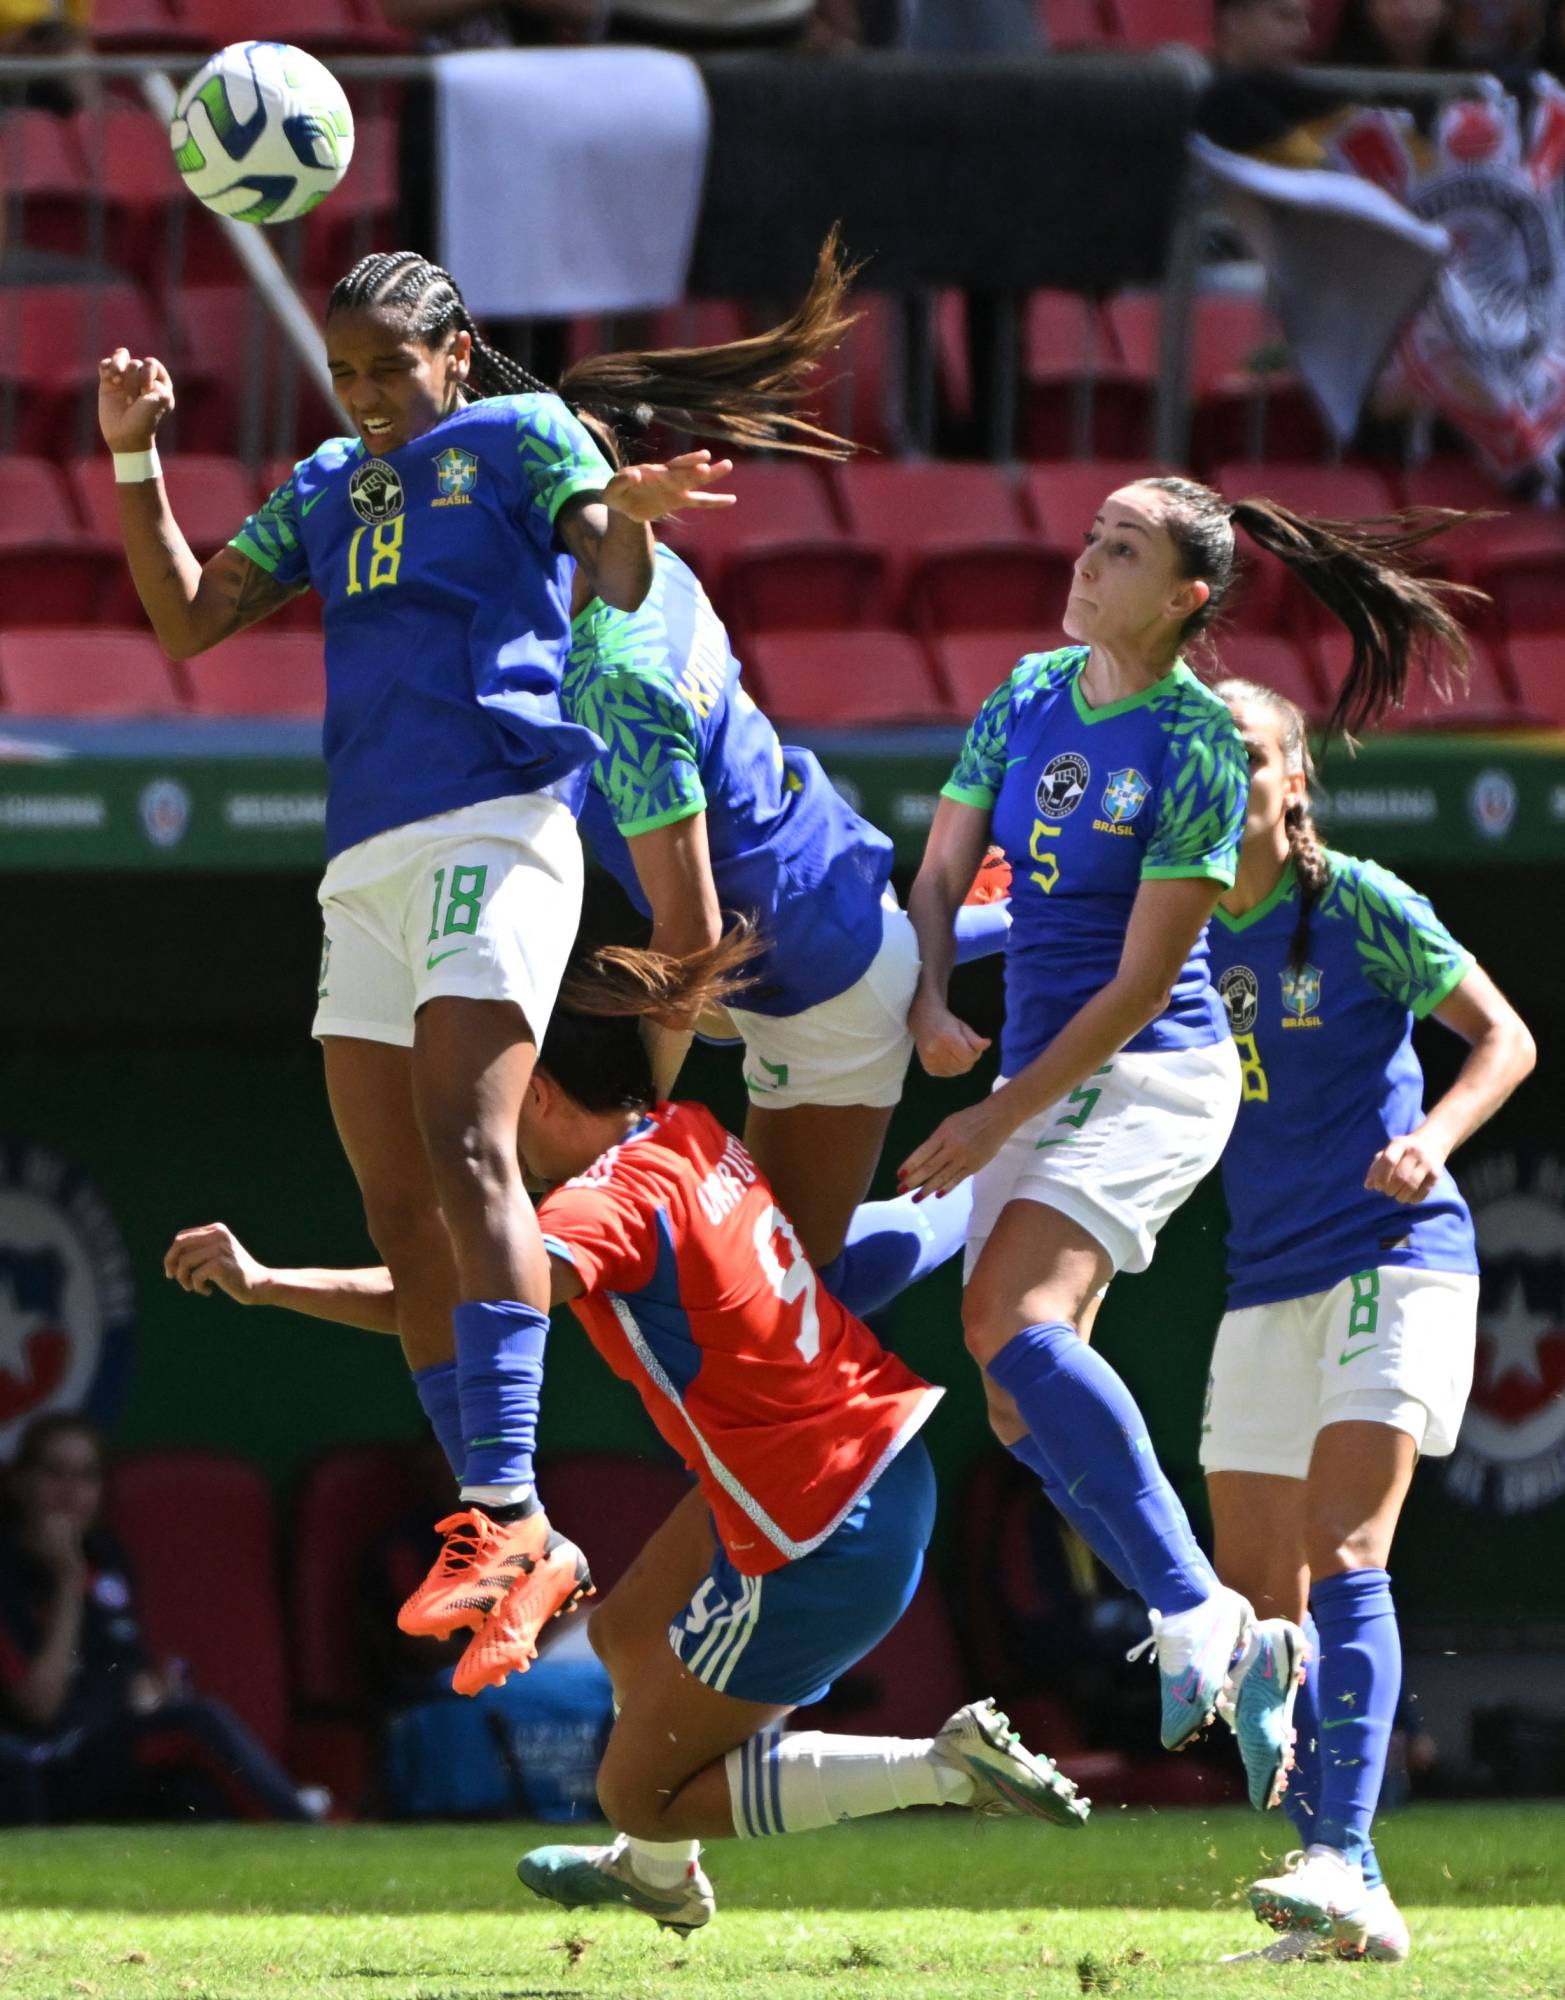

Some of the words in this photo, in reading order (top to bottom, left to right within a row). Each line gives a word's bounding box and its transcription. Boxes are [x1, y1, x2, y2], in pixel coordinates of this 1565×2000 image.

[431, 494, 472, 507] BRASIL
[346, 513, 405, 595] 18
[1029, 818, 1062, 895] 5
[1092, 819, 1135, 836] BRASIL
[427, 864, 488, 945] 18
[1281, 1016, 1323, 1028] BRASIL
[753, 1203, 820, 1365] 9
[1348, 1268, 1380, 1338] 8
